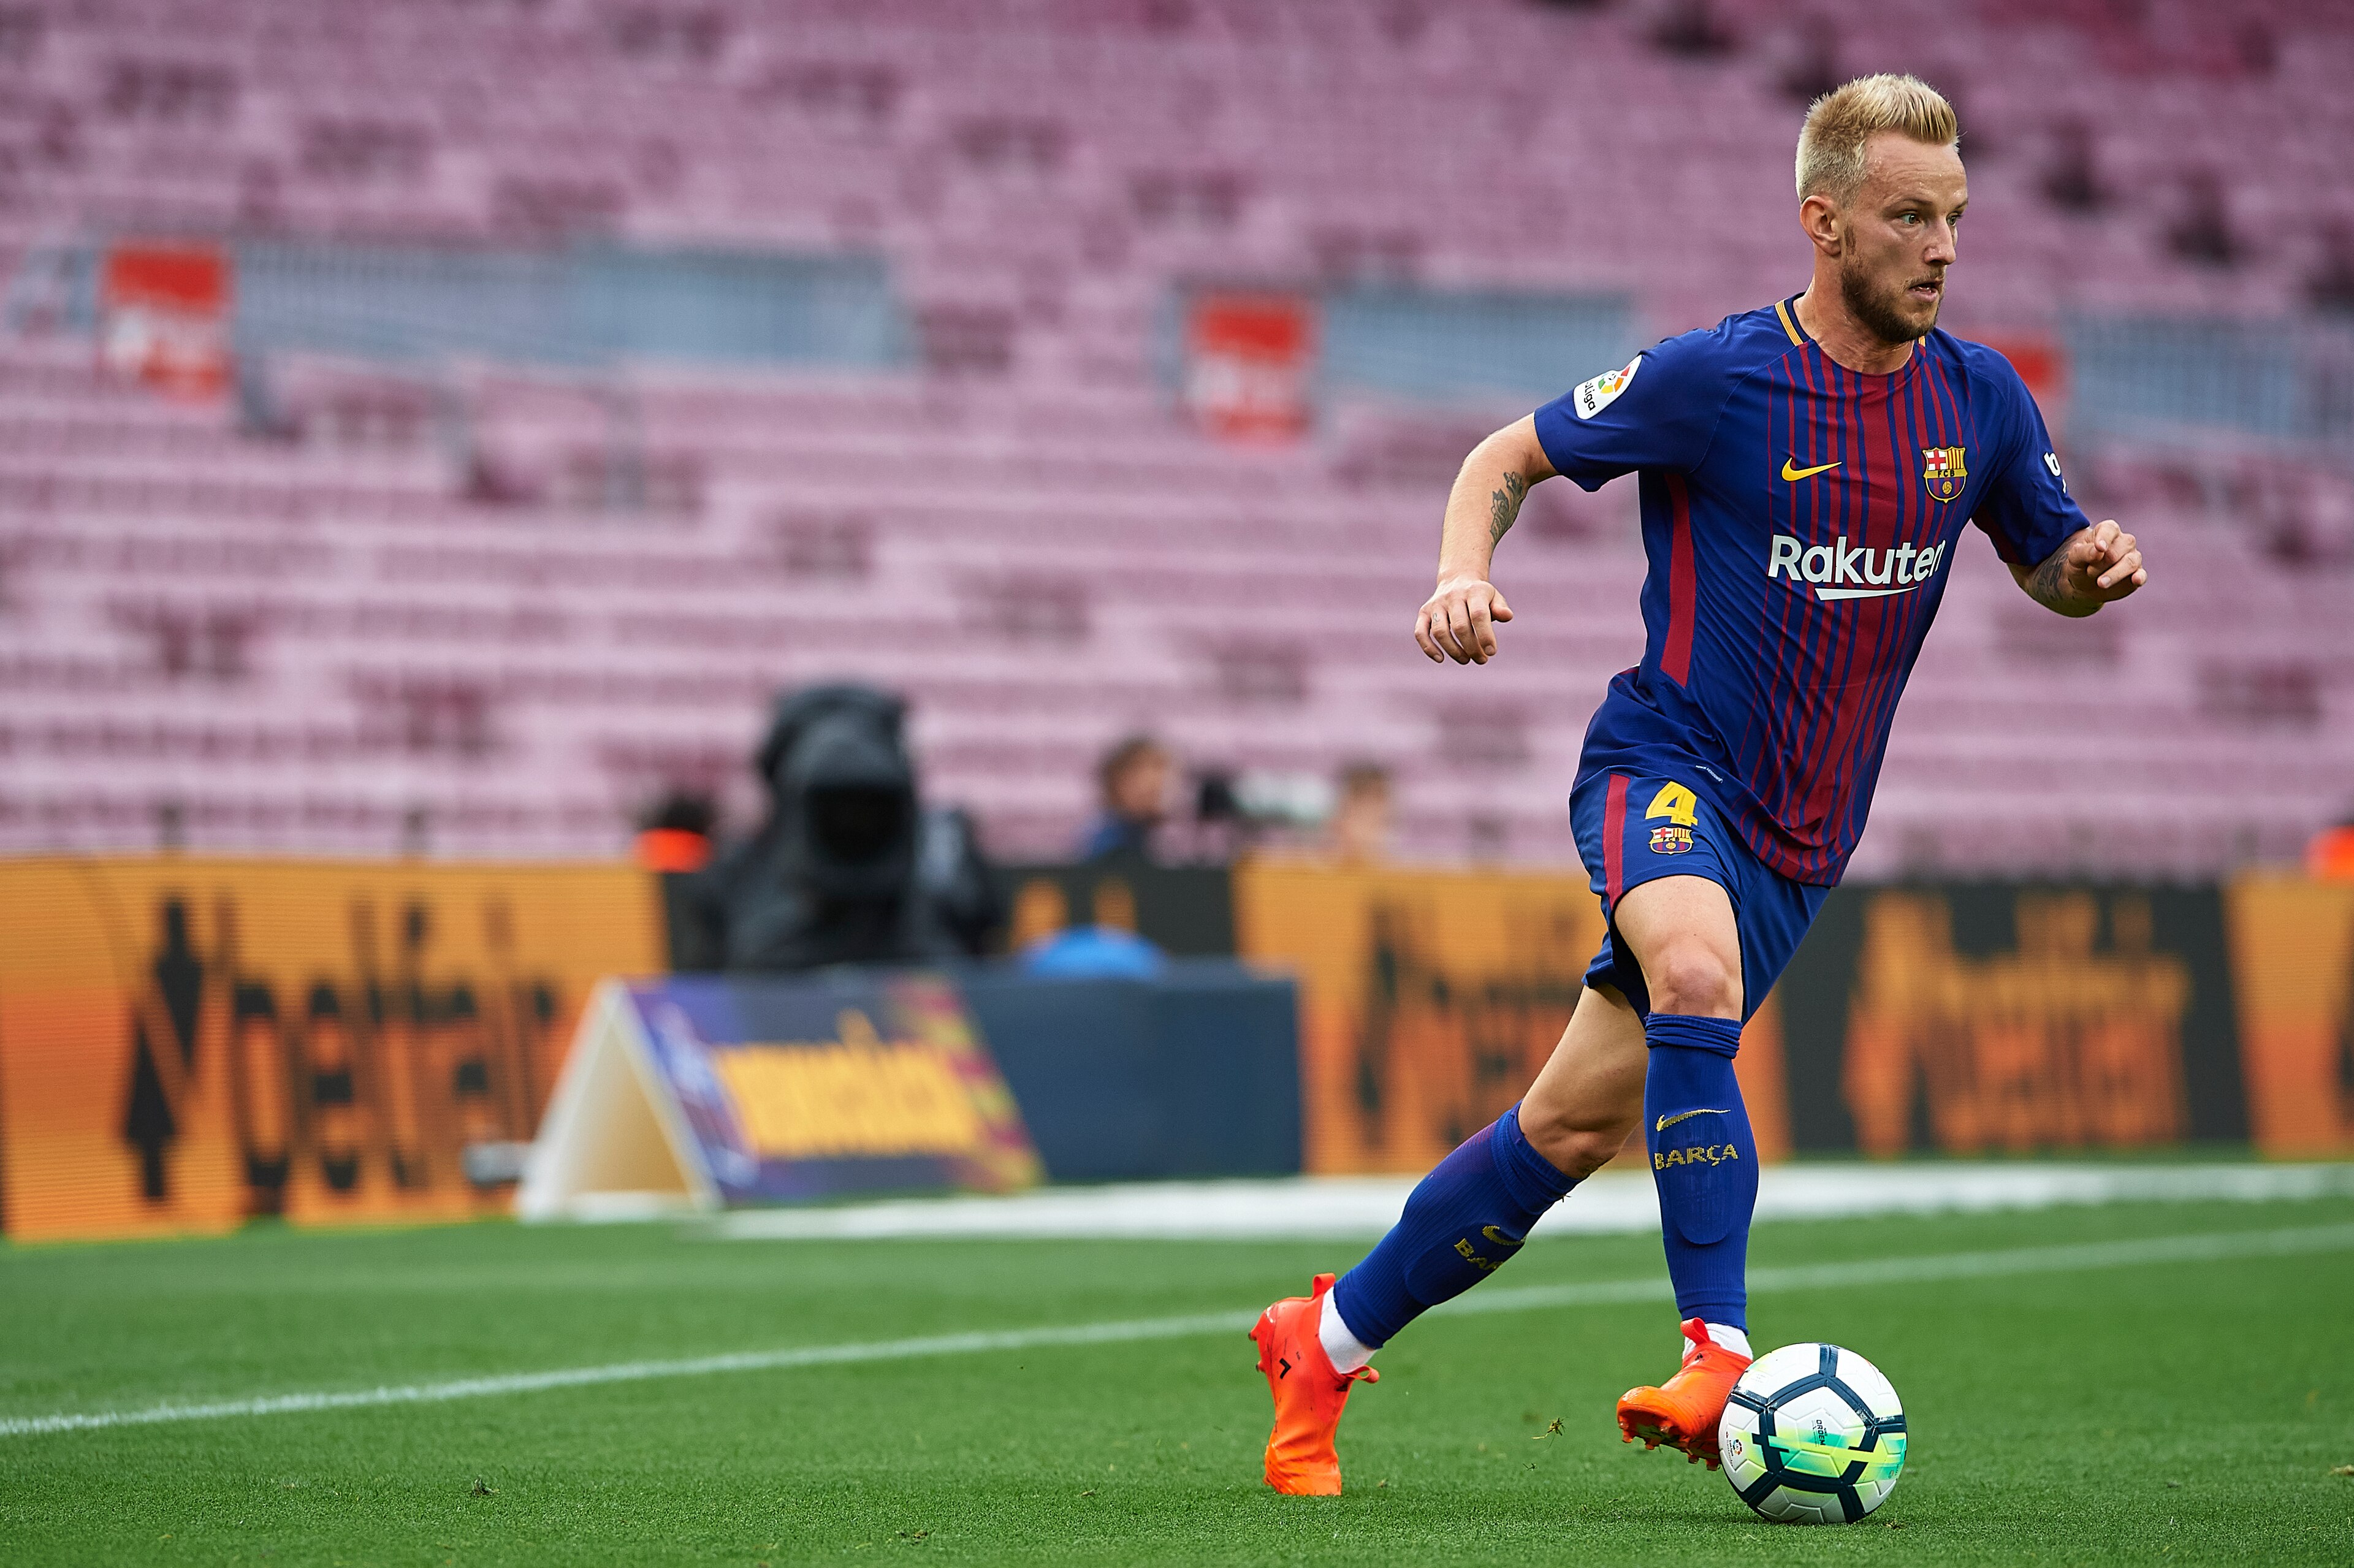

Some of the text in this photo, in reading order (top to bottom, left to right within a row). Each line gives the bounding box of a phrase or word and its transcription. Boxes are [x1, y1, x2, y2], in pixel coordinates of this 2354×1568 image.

[1768, 534, 1946, 585] Rakuten
[1645, 780, 1699, 828] 4
[1654, 1143, 1739, 1170] BARÇA
[1816, 1419, 1826, 1445] ORDEM
